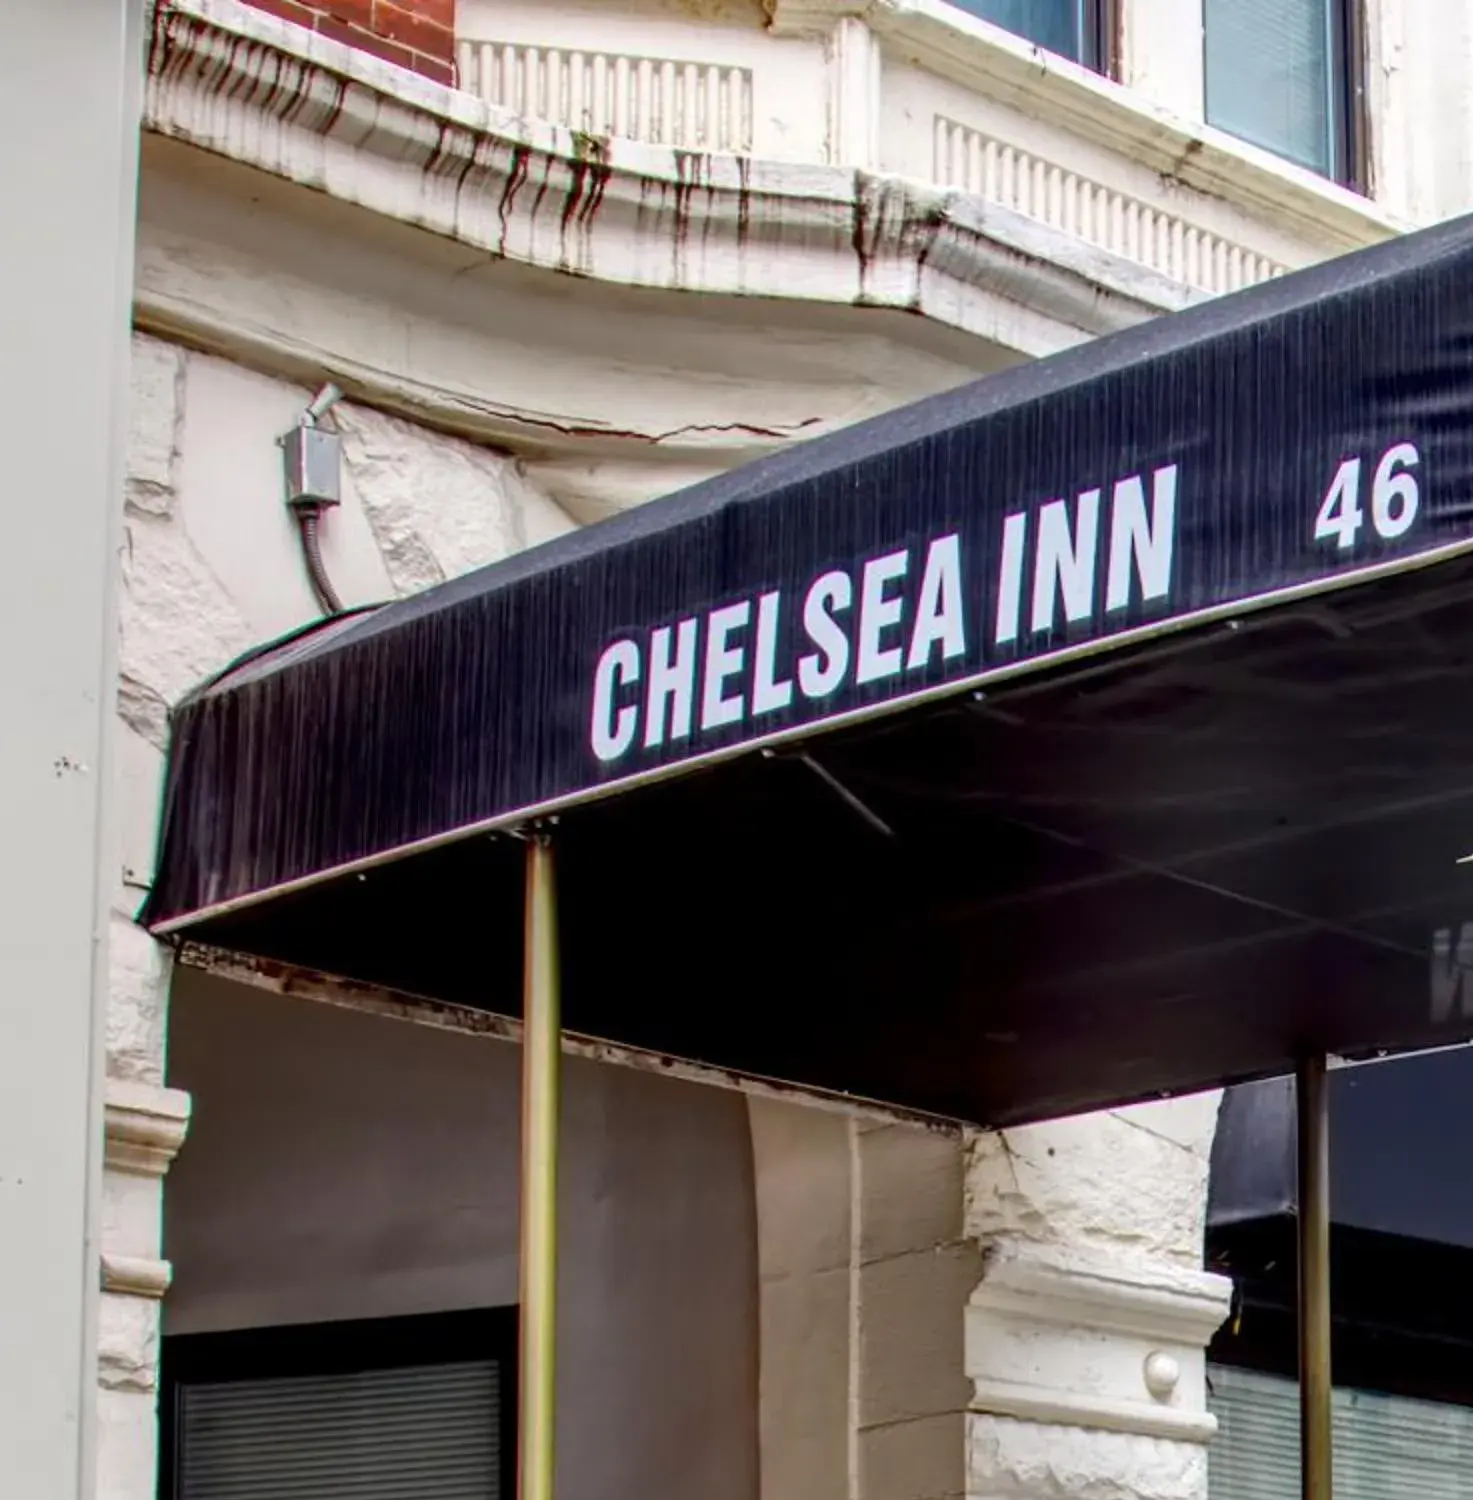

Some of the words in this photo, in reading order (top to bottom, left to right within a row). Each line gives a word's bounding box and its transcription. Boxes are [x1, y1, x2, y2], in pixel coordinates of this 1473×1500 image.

[1313, 442, 1420, 549] 46
[590, 533, 966, 762] CHELSEA
[994, 463, 1178, 645] INN
